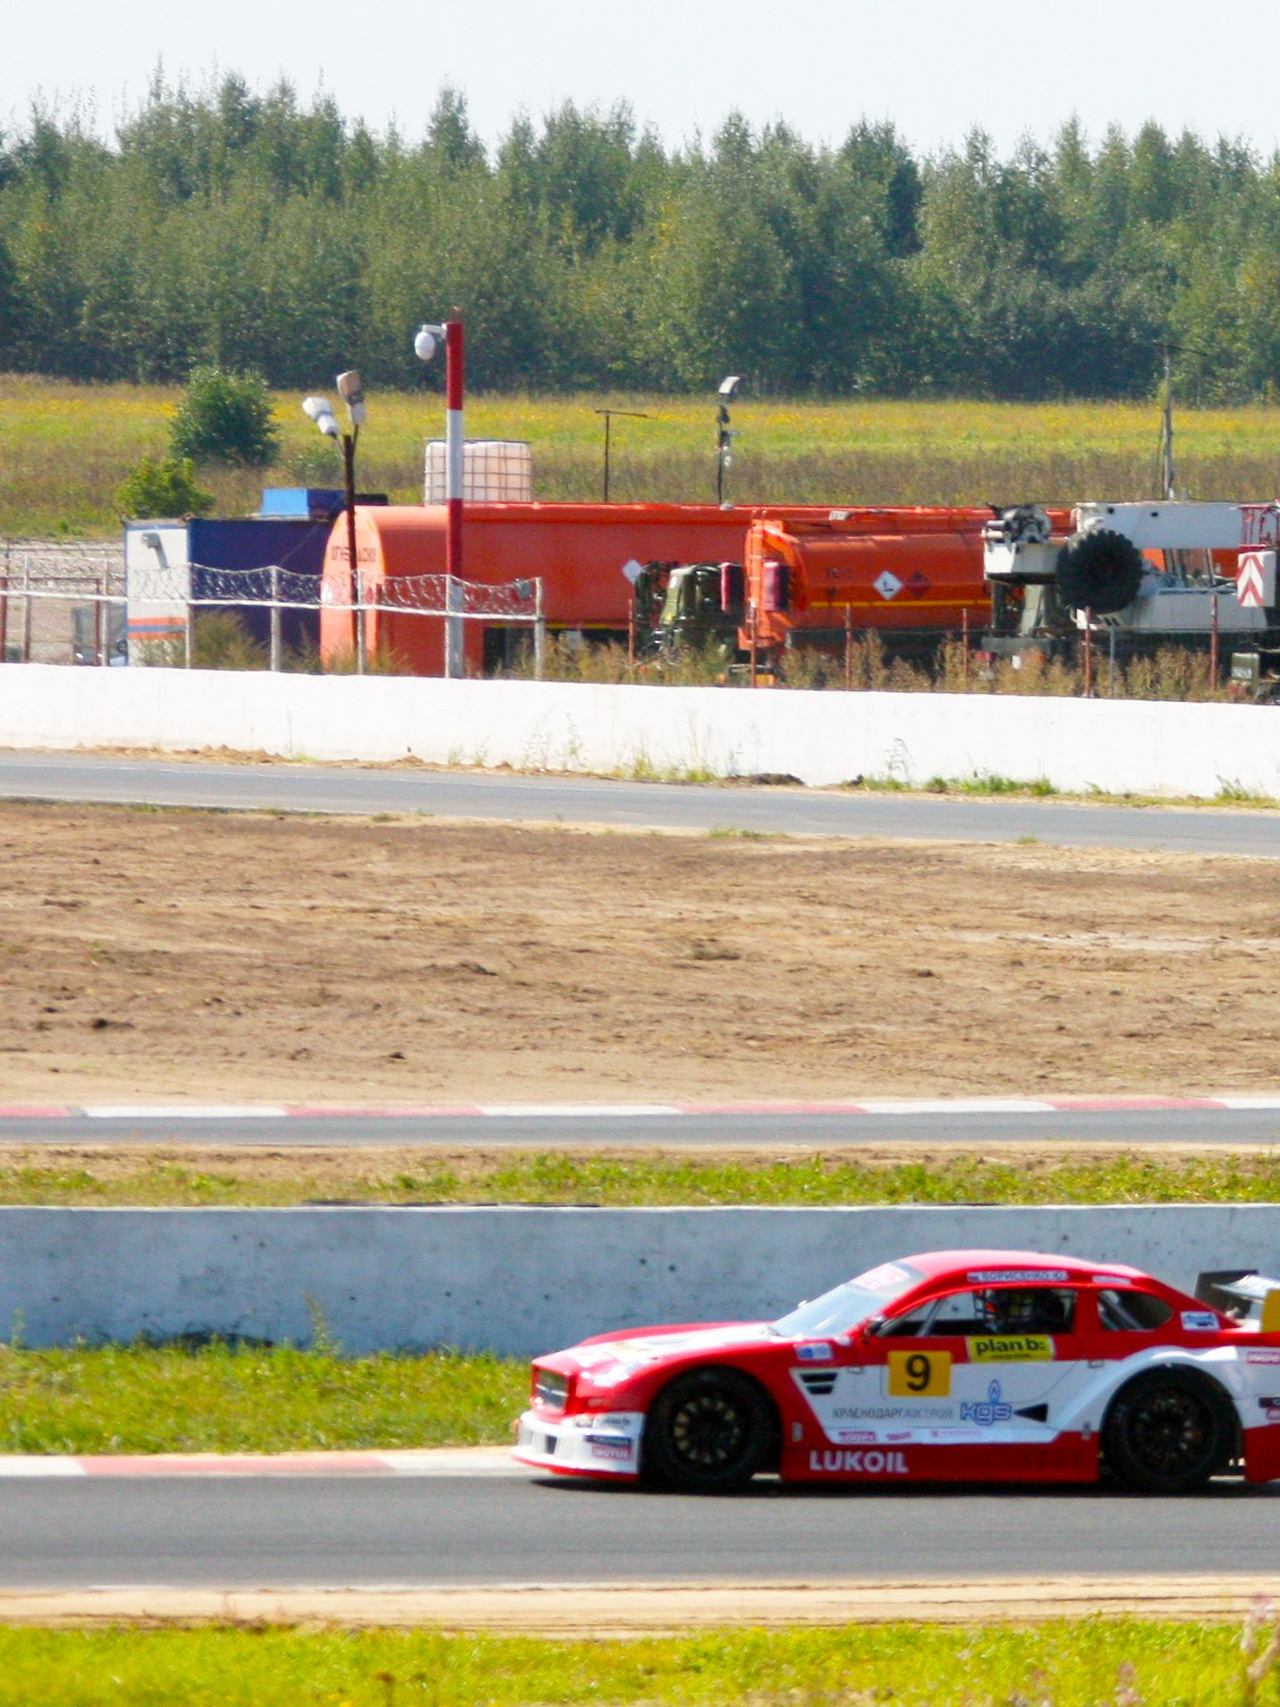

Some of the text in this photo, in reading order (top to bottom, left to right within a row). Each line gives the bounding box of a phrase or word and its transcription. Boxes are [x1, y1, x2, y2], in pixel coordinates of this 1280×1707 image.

[976, 1338, 1023, 1355] plan
[905, 1354, 931, 1391] 9
[809, 1449, 910, 1474] LUKOIL
